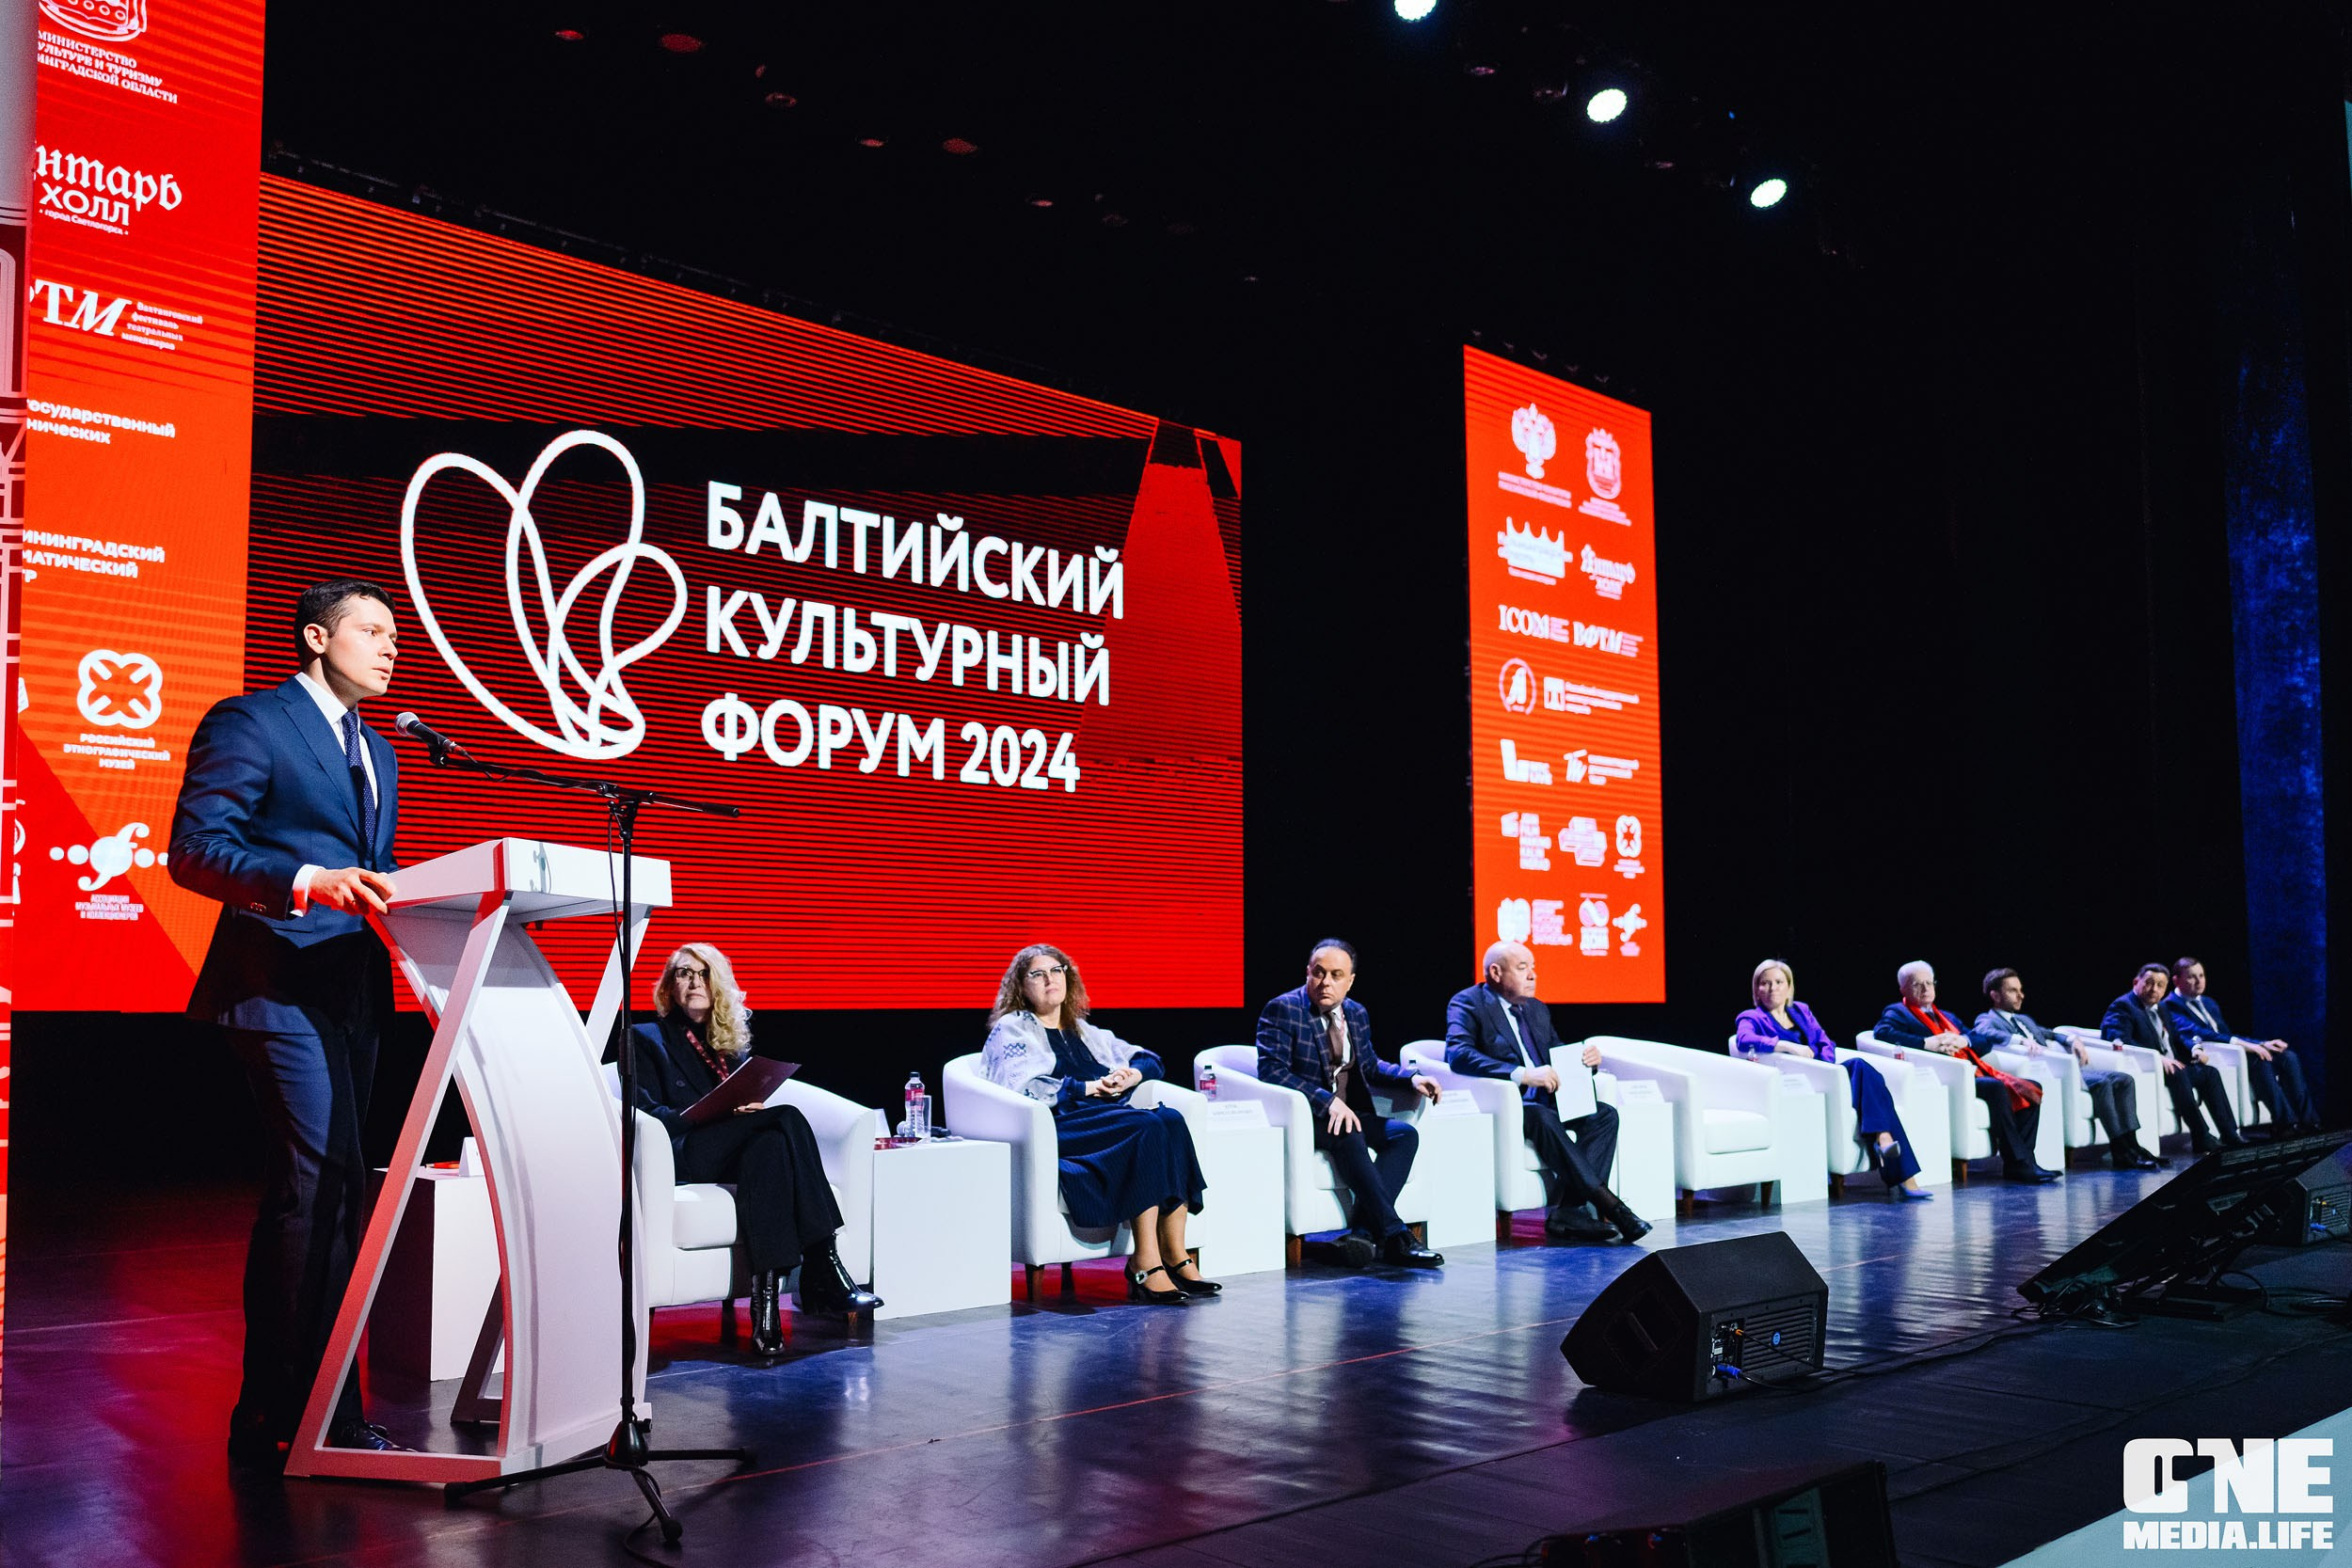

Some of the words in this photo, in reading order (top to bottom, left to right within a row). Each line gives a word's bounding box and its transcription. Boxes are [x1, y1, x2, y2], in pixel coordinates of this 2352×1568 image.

[94, 58, 104, 70] И
[105, 62, 163, 87] ТУРИЗМУ
[34, 145, 183, 212] нтарь
[39, 182, 129, 226] ХОЛЛ
[29, 278, 133, 337] ТМ
[707, 481, 1123, 620] БАЛТИЙСКИЙ
[706, 585, 1109, 706] КУЛЬТУРНЫЙ
[700, 692, 946, 781] ФОРУМ
[960, 721, 1081, 793] 2024
